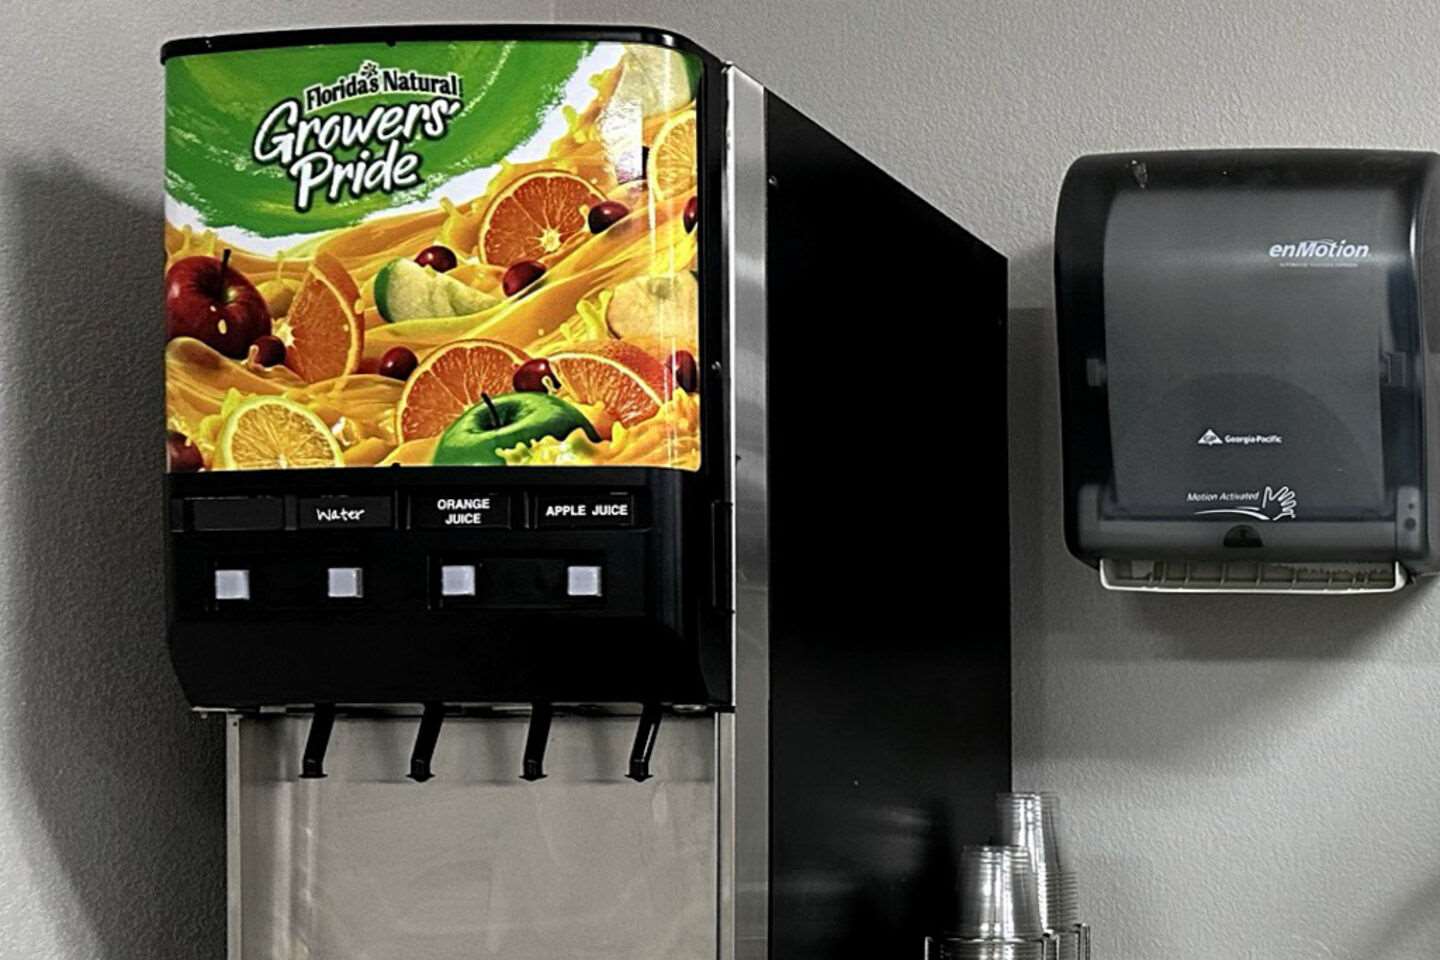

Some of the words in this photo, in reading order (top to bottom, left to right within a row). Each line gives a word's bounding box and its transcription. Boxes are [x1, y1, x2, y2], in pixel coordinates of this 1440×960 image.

[383, 70, 457, 96] Natural
[290, 139, 420, 209] Pride
[1269, 239, 1370, 258] enMotion
[1186, 491, 1219, 502] Motion
[1219, 490, 1260, 501] Activated
[437, 498, 490, 511] ORANGE
[545, 504, 587, 517] APPLE
[591, 504, 629, 516] JUICE
[316, 508, 365, 522] Water
[444, 512, 482, 525] JUICE
